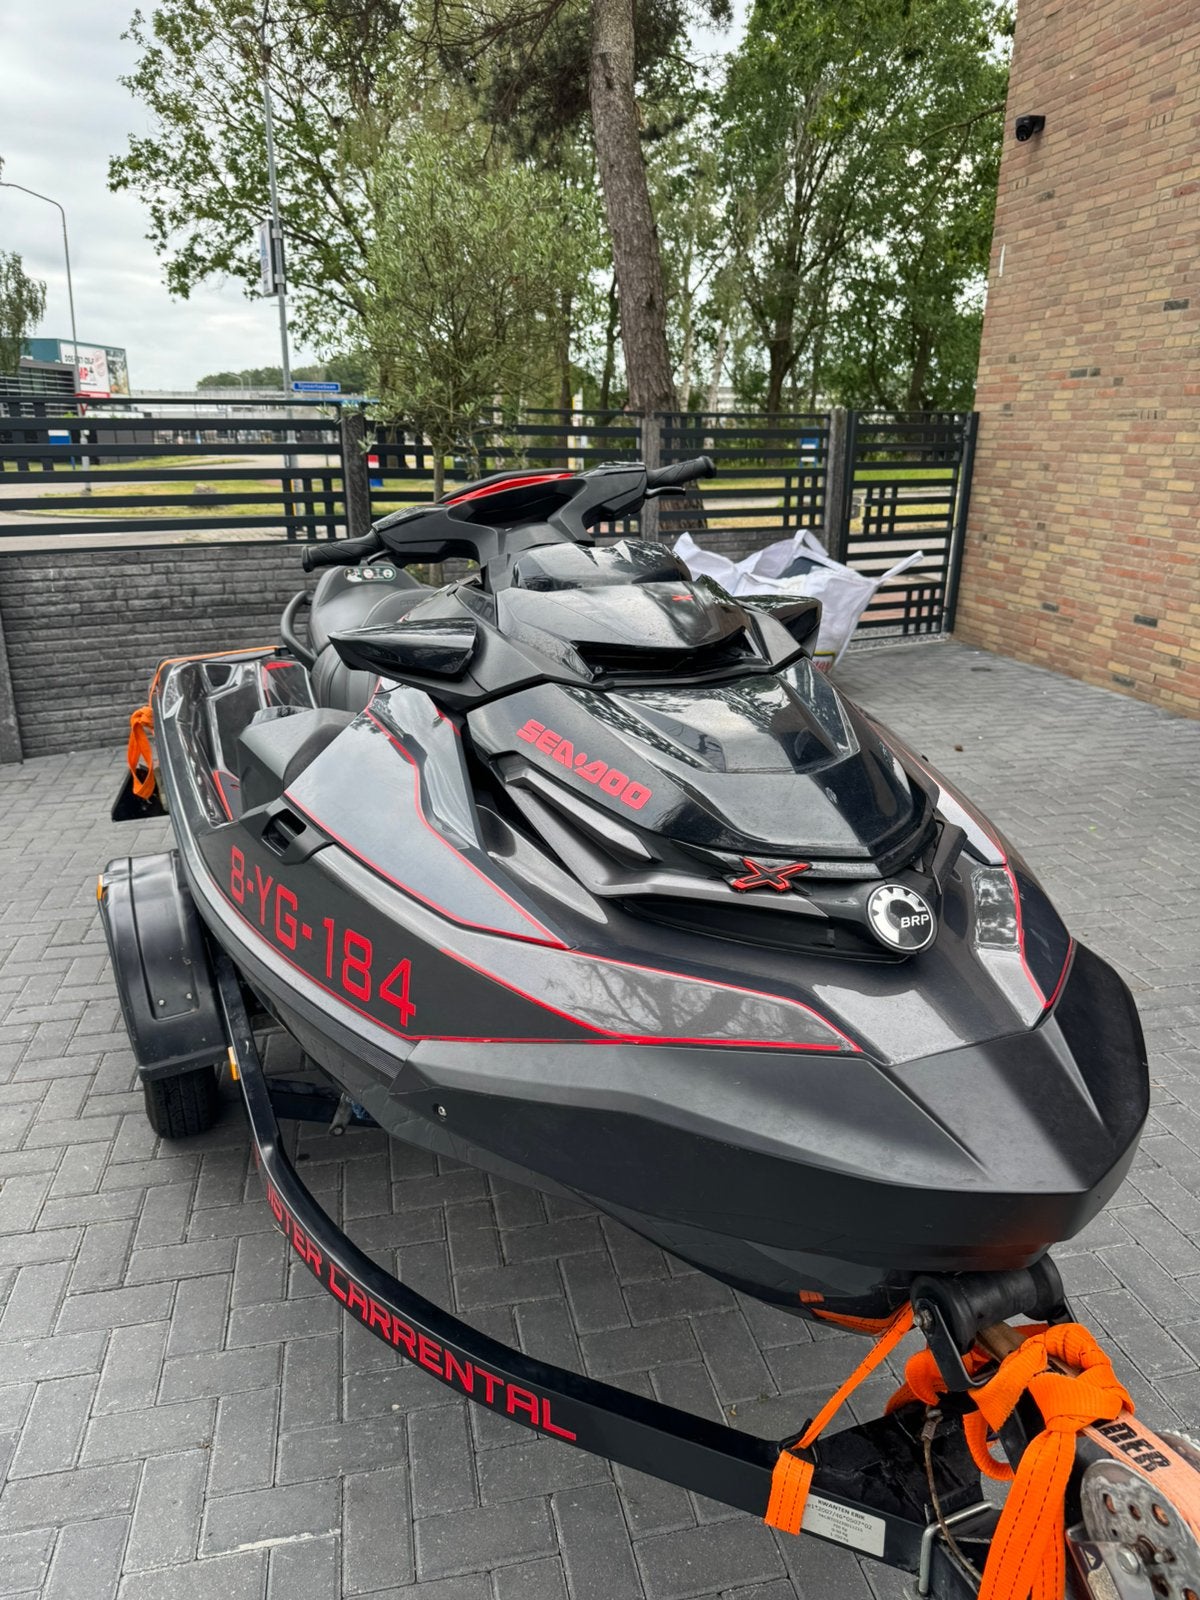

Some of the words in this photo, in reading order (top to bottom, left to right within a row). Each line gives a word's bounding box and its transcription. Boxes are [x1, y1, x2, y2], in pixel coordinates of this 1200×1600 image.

[230, 846, 417, 1028] 8-YG-184
[900, 914, 930, 929] BRP
[327, 1261, 577, 1441] CARRENTAL
